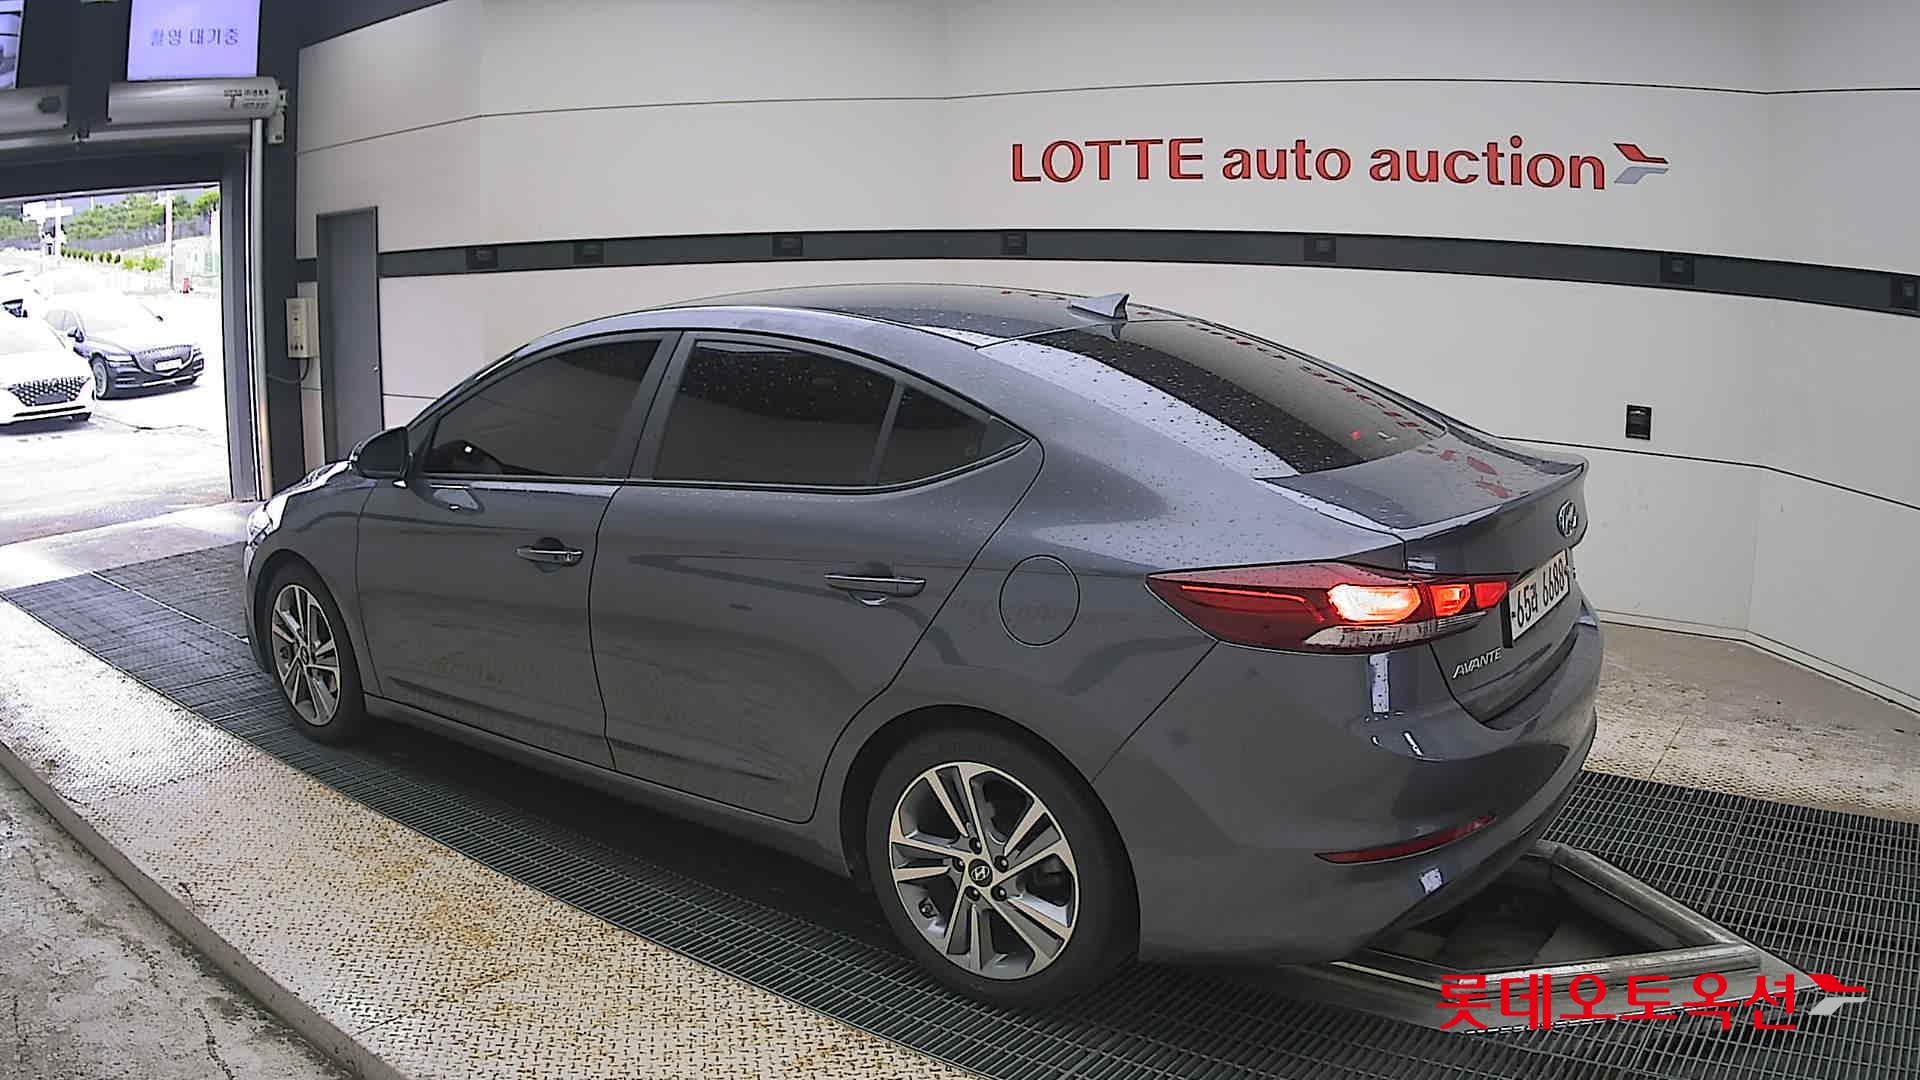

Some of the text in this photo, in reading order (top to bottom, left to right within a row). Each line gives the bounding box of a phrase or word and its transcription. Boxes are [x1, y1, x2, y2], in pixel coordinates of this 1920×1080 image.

[189, 28, 239, 47] 대기중
[1011, 135, 1606, 191] LOTTE auto auction
[1452, 647, 1502, 679] AVANTE
